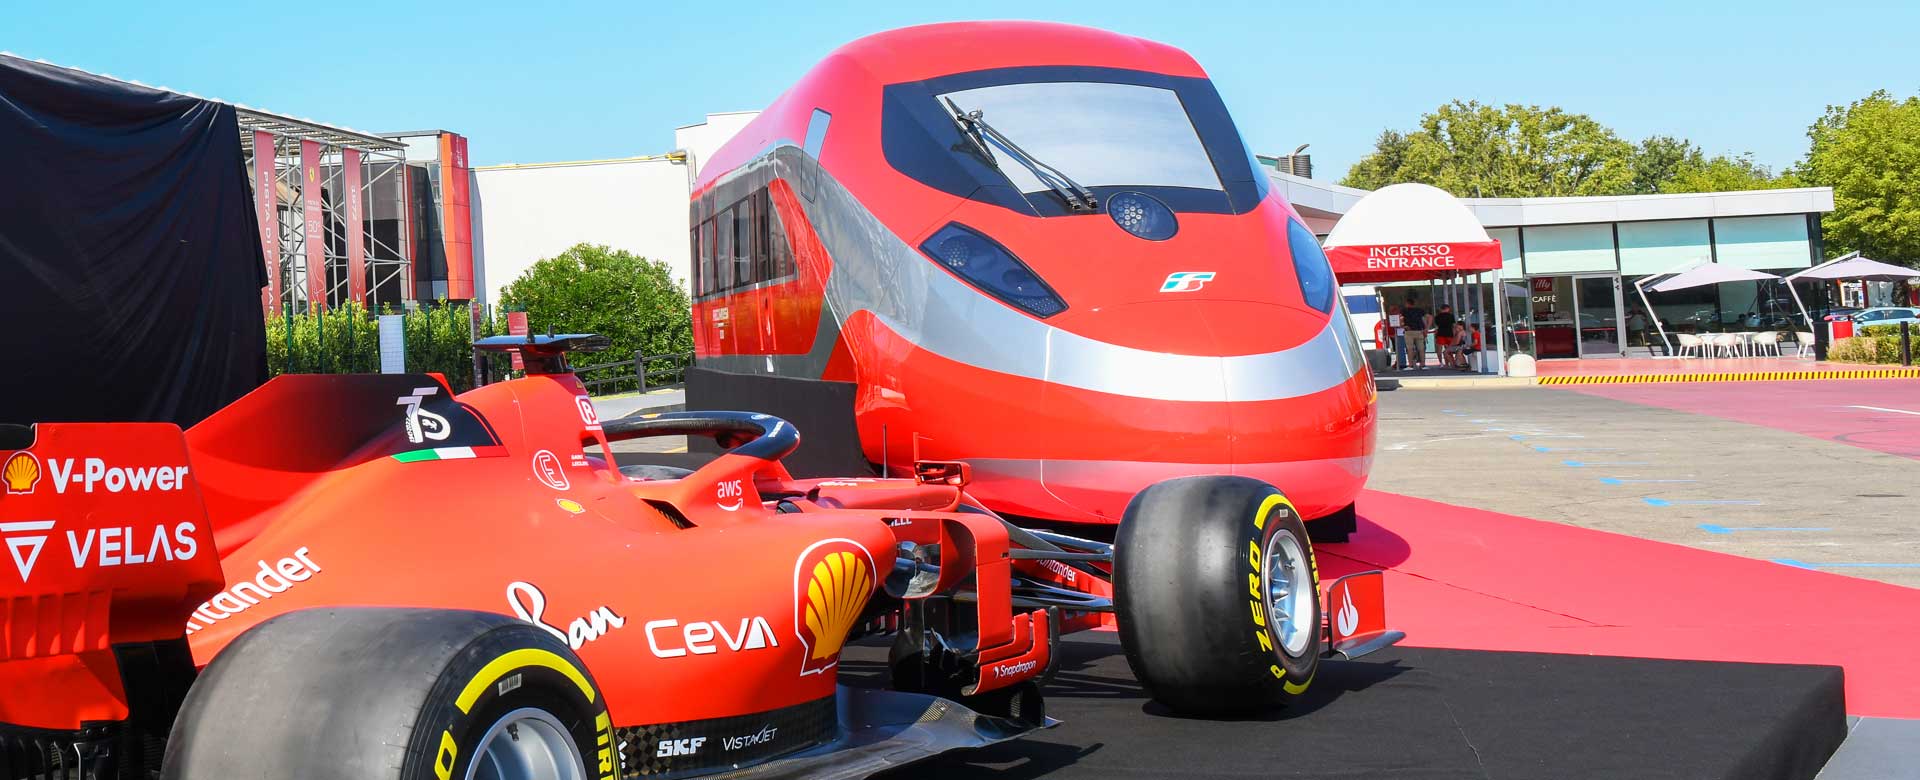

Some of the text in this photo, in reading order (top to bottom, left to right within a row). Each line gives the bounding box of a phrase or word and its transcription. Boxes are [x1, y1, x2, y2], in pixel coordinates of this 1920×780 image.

[263, 171, 271, 223] PISTA
[265, 227, 272, 244] DI
[1370, 245, 1450, 257] INGRESSO
[1367, 256, 1455, 269] ENTRANCE
[1535, 279, 1552, 292] illy
[47, 458, 188, 493] V-Power
[717, 479, 742, 498] aws
[66, 522, 197, 568] VELAS
[1249, 541, 1287, 680] P ZERO
[1000, 659, 1037, 677] Snapdragon
[656, 737, 707, 758] SKF
